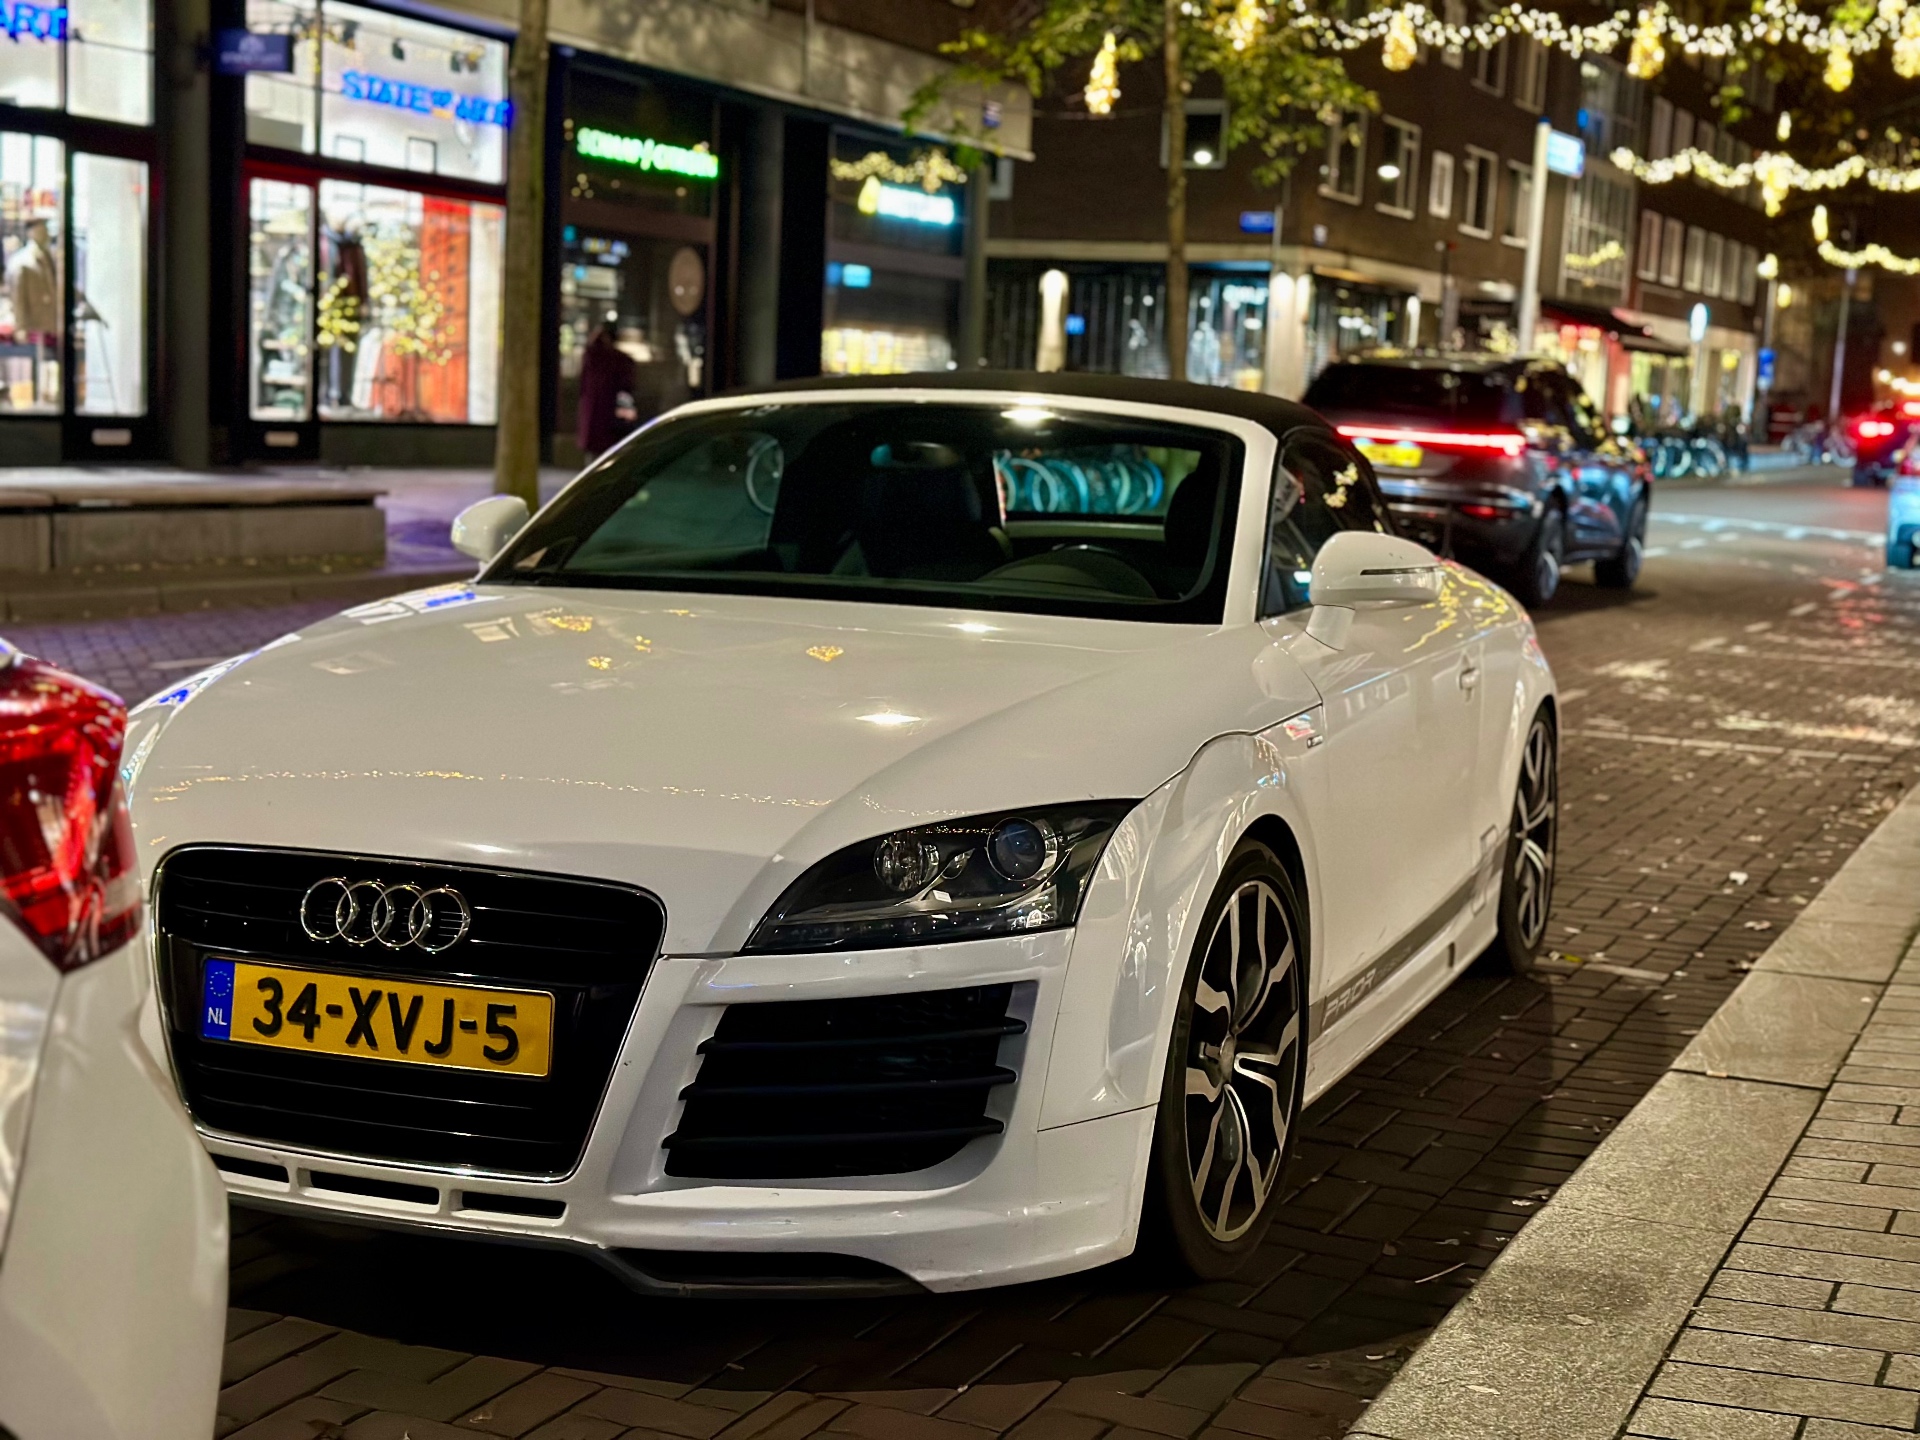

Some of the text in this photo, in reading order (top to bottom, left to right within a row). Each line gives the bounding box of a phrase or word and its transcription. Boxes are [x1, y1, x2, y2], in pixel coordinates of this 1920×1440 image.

[342, 70, 431, 114] STATE
[207, 1006, 228, 1027] NL
[252, 976, 520, 1062] 34-XVJ-5
